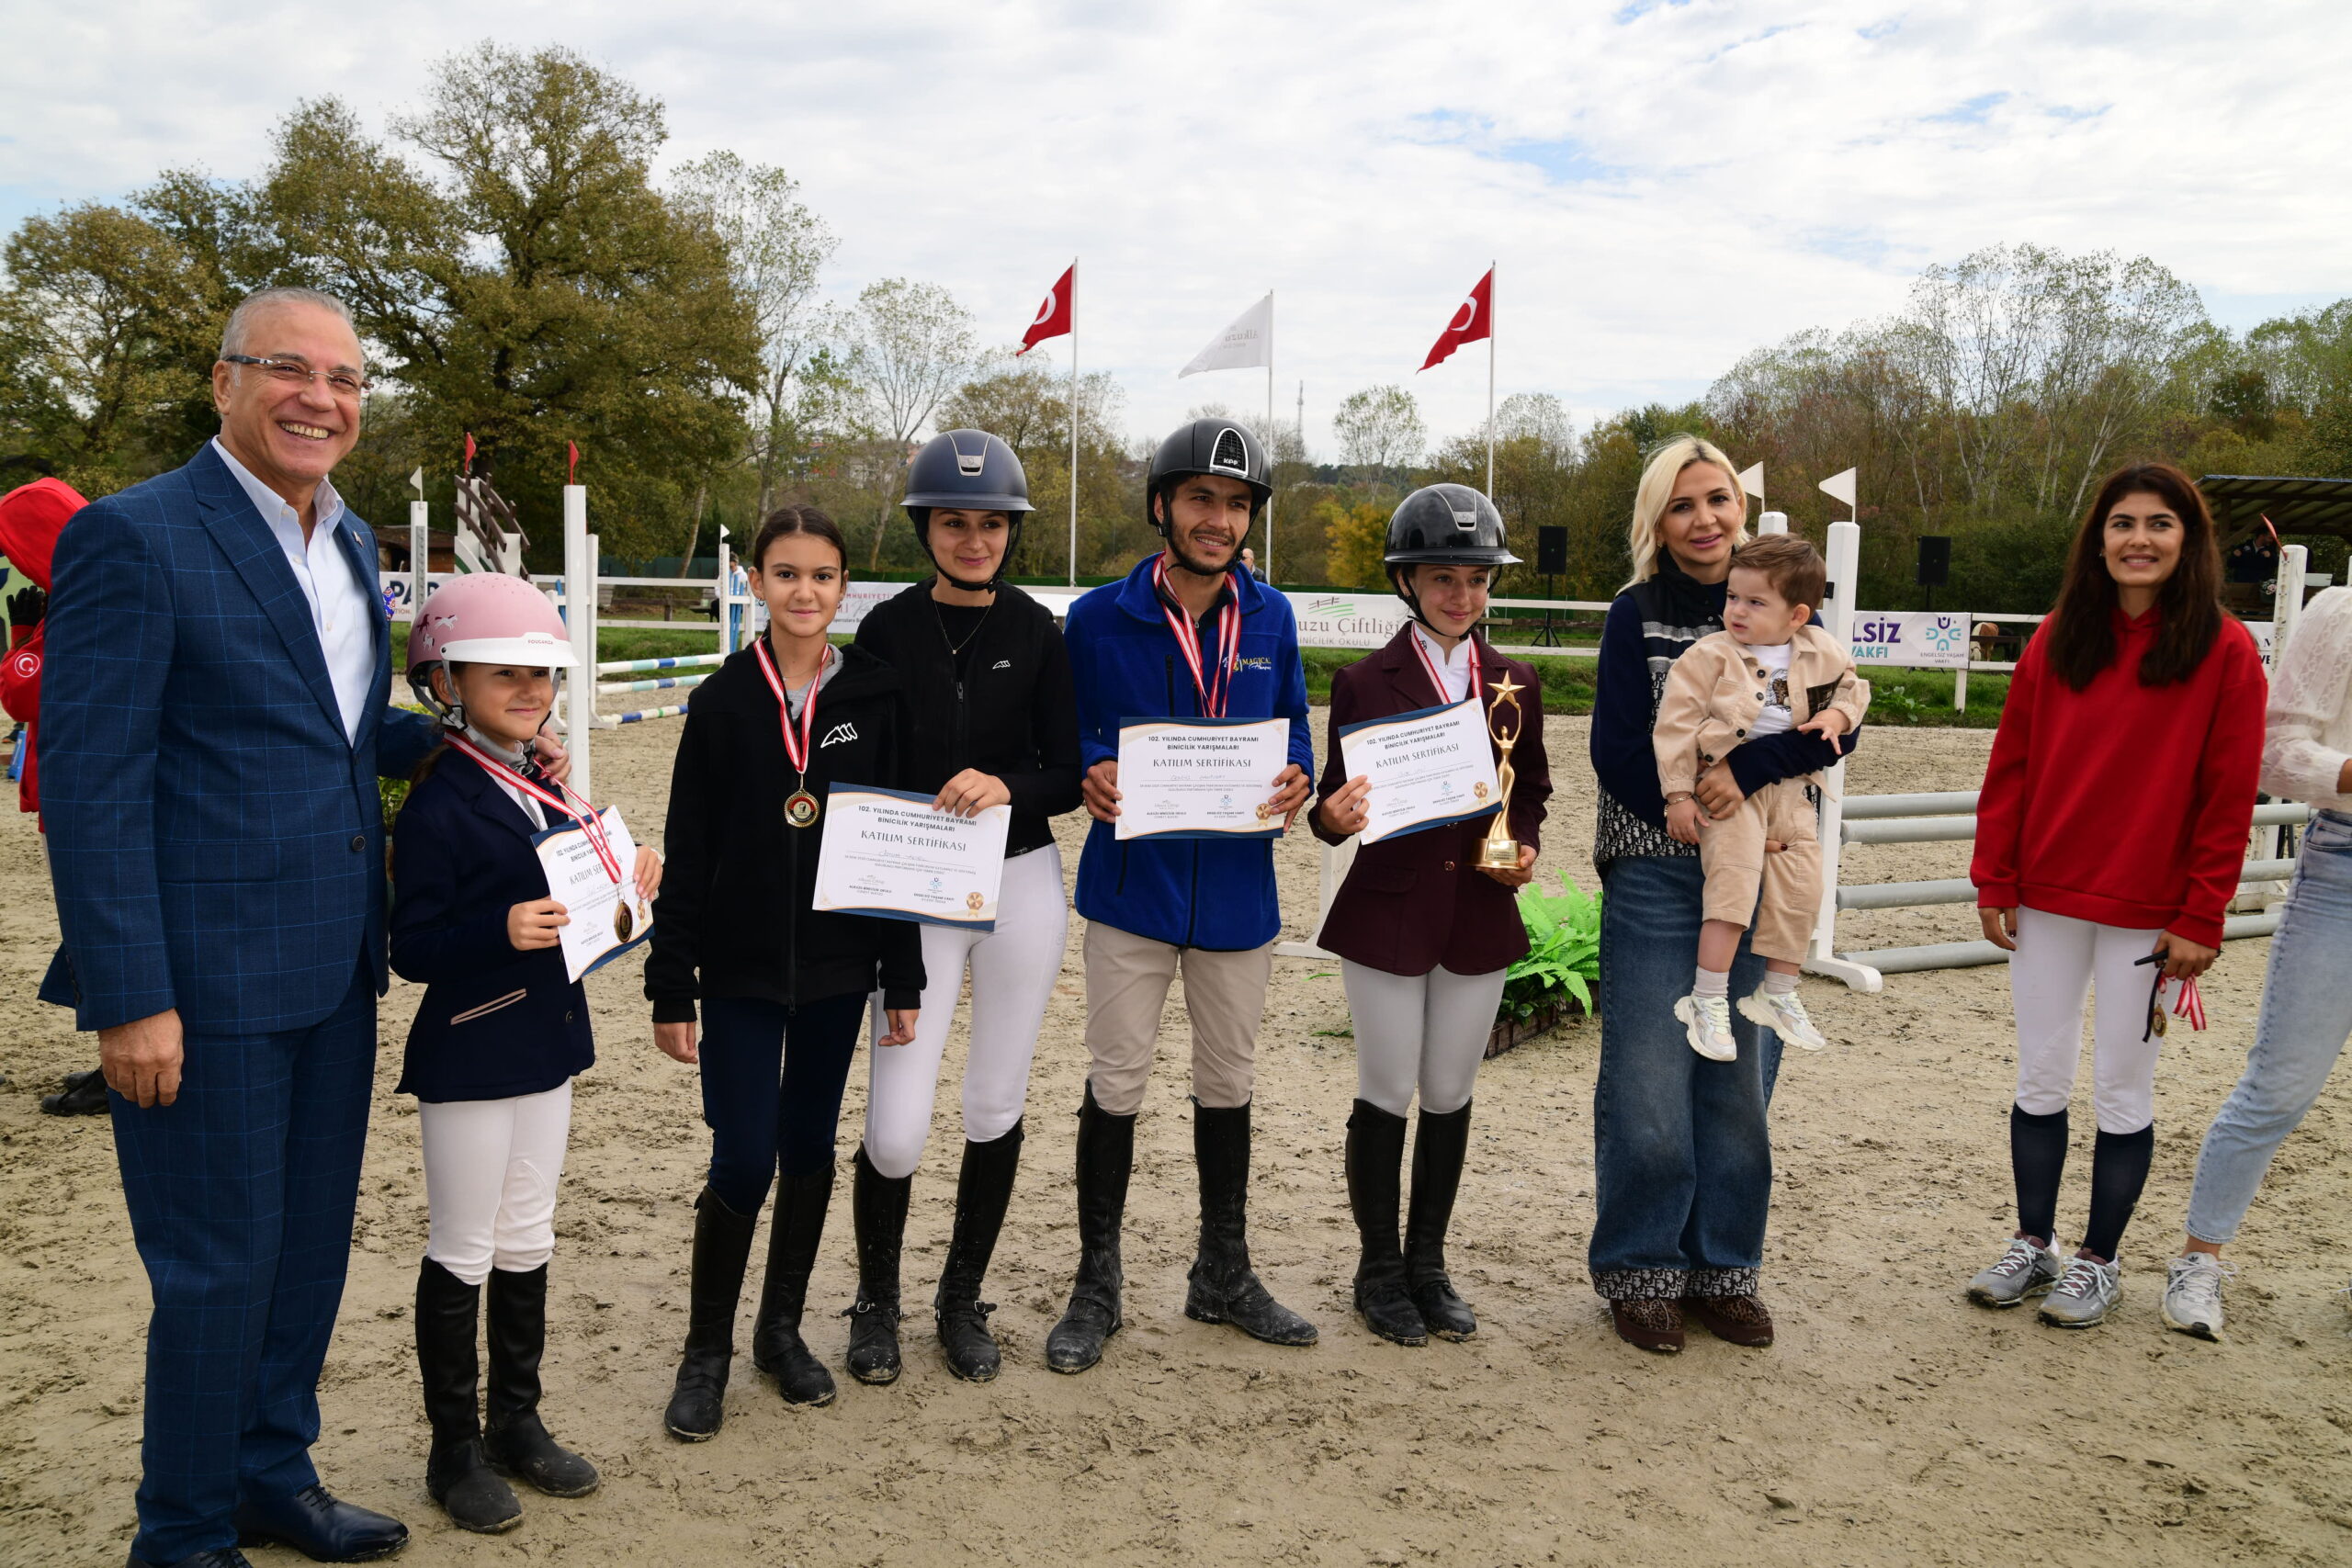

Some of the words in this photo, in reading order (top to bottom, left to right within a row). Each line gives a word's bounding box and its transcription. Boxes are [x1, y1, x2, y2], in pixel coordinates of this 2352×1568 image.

[1339, 638, 1371, 647] OKULU
[1378, 734, 1399, 742] YILINDA
[1434, 720, 1460, 731] BAYRAMI
[1409, 732, 1445, 743] YARIŞMALARI
[1153, 759, 1193, 767] KATILIM
[1196, 757, 1251, 767] SERTİFİKASI
[1375, 754, 1409, 769] KATILIM
[1412, 742, 1459, 761] SERTİFİKASI
[873, 807, 899, 816] YILINDA
[900, 811, 944, 822] CUMHURİYET
[945, 817, 977, 826] BAYRAMI
[877, 817, 908, 826] BİNİCİLİK
[910, 821, 955, 831] YARIŞMALARI
[861, 829, 903, 843] KATILIM
[908, 835, 966, 852] SERTİFİKASI
